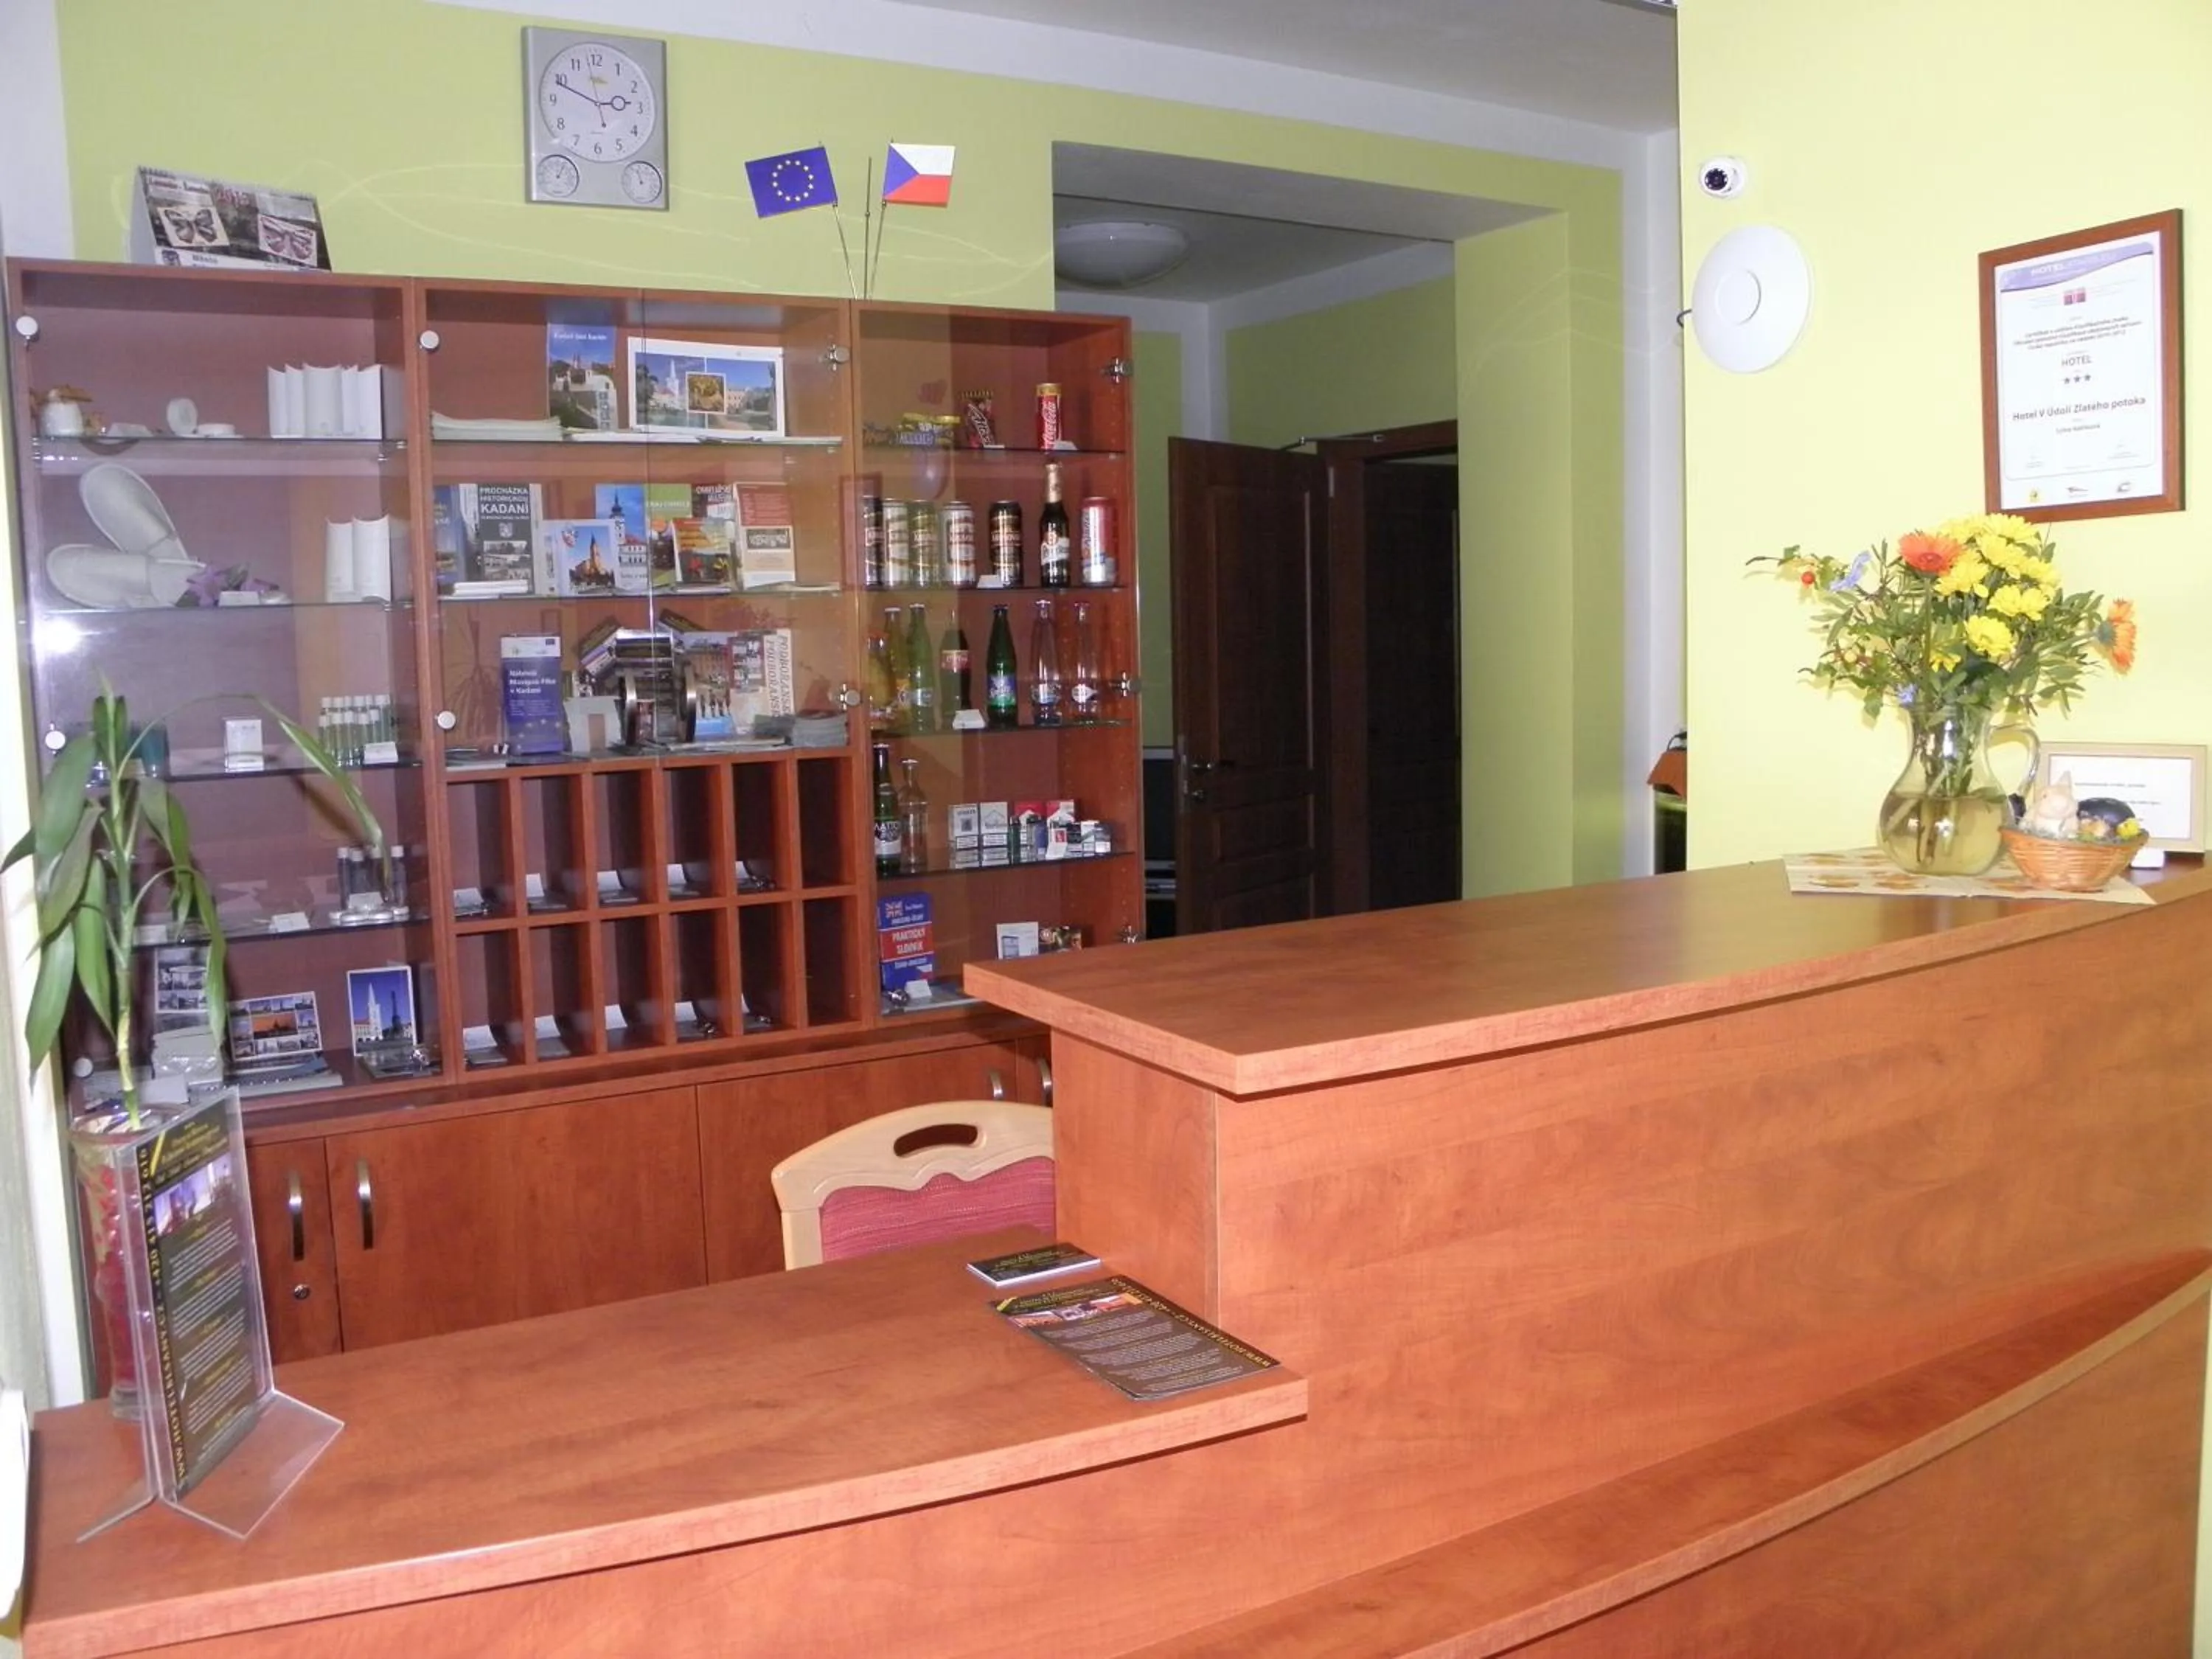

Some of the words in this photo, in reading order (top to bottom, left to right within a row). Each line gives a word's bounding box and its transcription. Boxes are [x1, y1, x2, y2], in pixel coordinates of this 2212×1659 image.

[571, 58, 581, 72] 11
[591, 54, 602, 66] 12
[615, 63, 621, 77] 1
[555, 73, 567, 86] 10
[630, 80, 638, 94] 2
[549, 94, 557, 106] 9
[637, 102, 644, 114] 3
[557, 117, 565, 131] 8
[630, 125, 639, 137] 4
[572, 134, 580, 146] 7
[616, 139, 623, 151] 5
[594, 142, 602, 155] 6
[2062, 355, 2093, 366] HOTEL
[2012, 409, 2037, 421] Hotel
